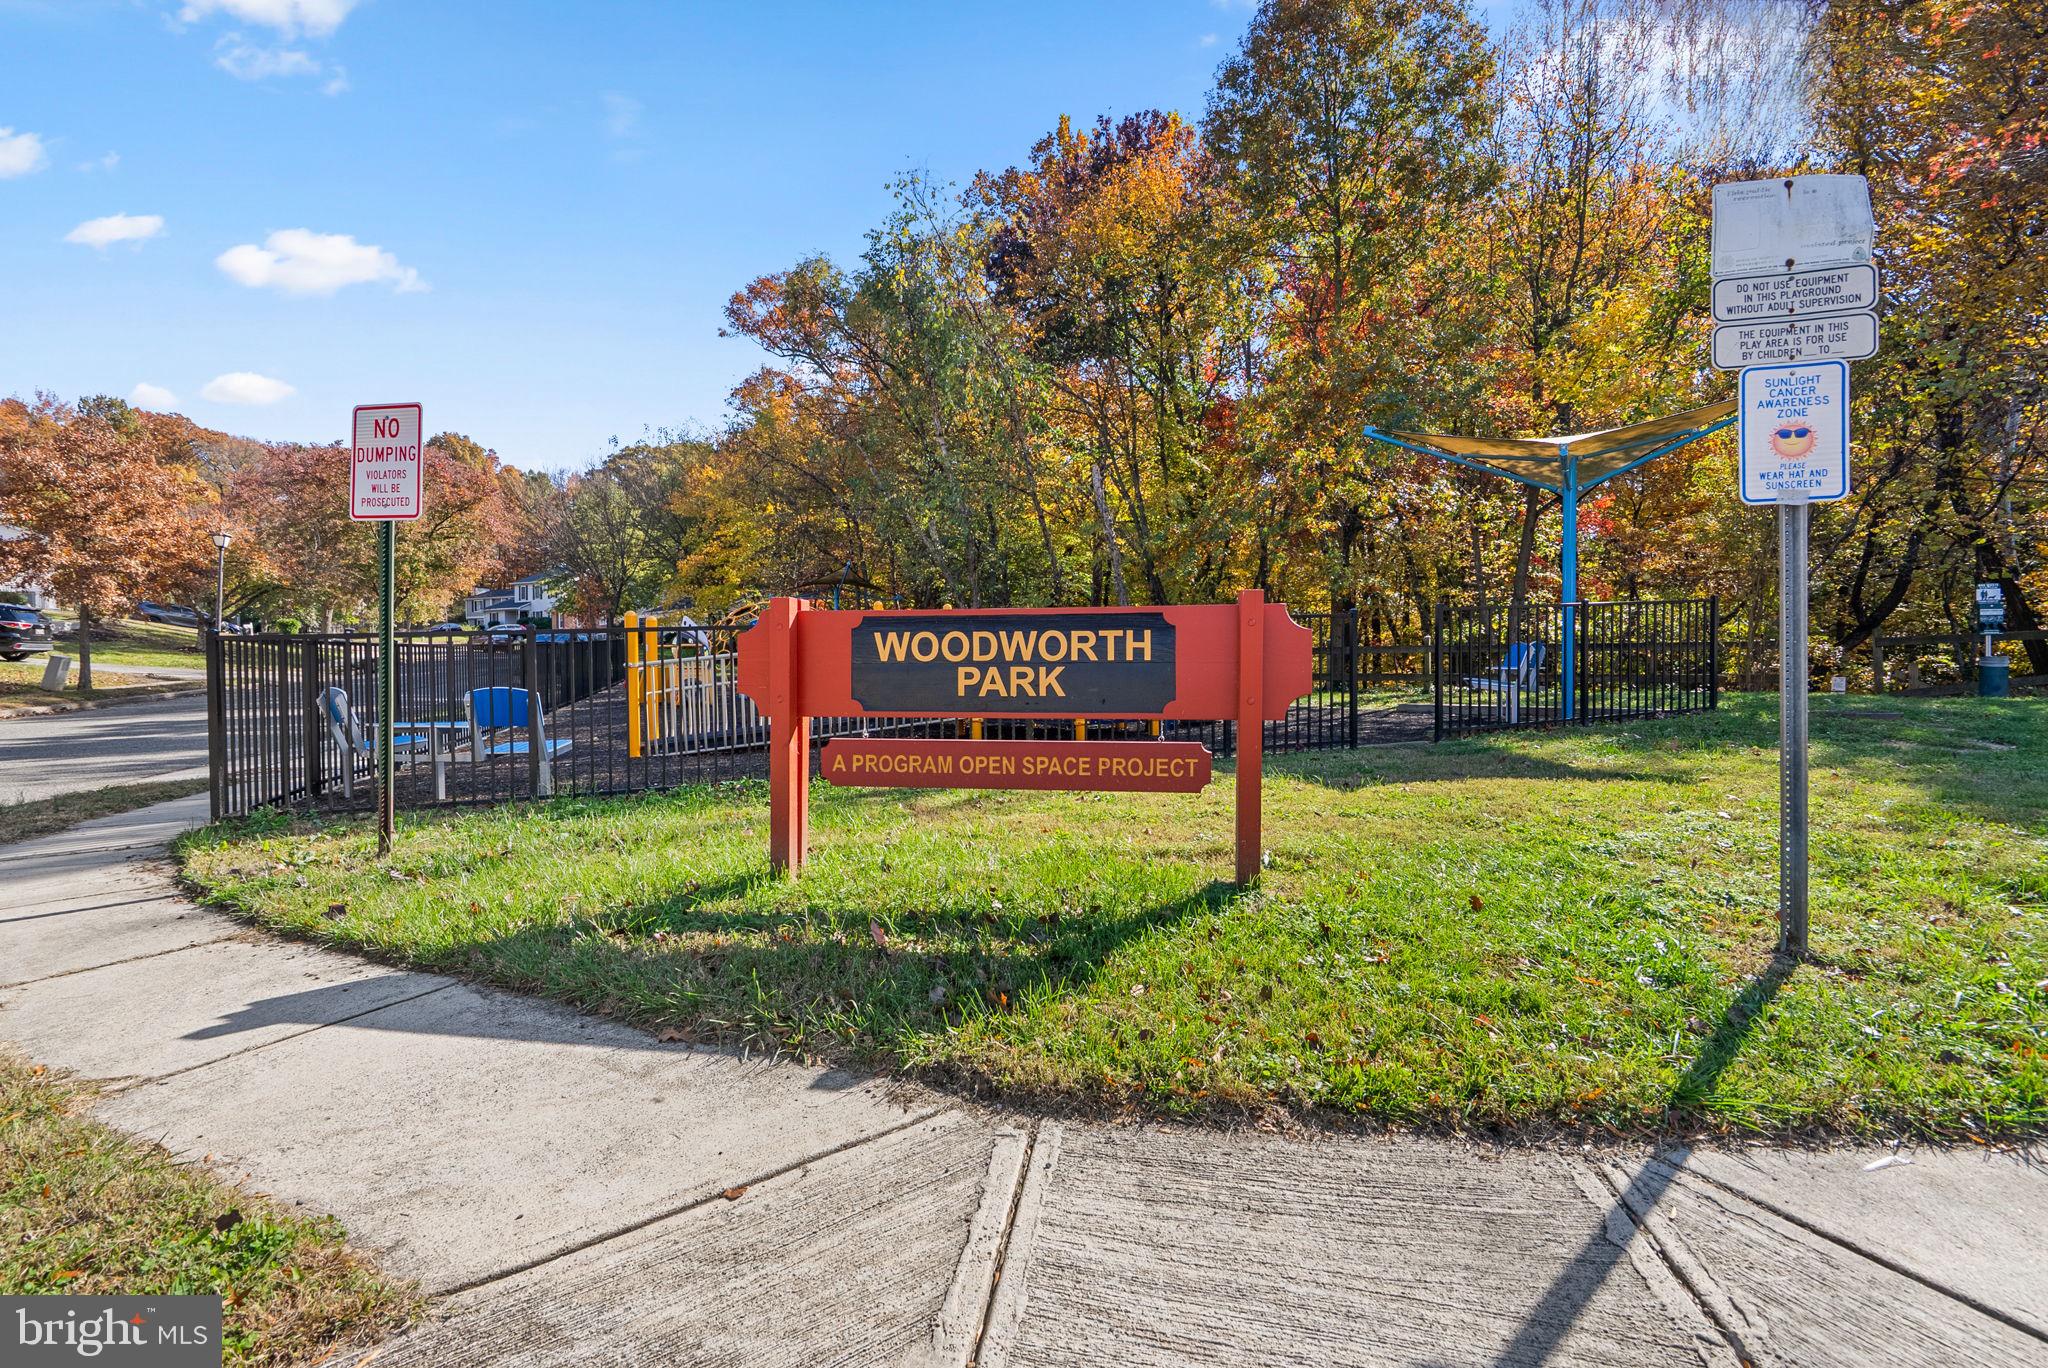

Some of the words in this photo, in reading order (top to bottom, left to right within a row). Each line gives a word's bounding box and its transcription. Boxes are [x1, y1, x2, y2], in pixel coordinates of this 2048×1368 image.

[1736, 284, 1749, 293] DO
[1753, 282, 1770, 292] NOT
[1773, 280, 1791, 290] USE
[1795, 273, 1849, 287] EQUIPMENT
[1744, 294, 1753, 303] IN
[1757, 292, 1776, 302] THIS
[1780, 285, 1841, 300] PLAYGROUND
[1726, 303, 1764, 315] WITHOUT
[1767, 301, 1795, 312] ADULT
[1799, 293, 1862, 309] SUPERVISION
[1739, 330, 1755, 340] THE
[1760, 325, 1811, 338] EQUIPMENT
[1814, 324, 1824, 333] IN
[1828, 322, 1849, 332] THIS
[1740, 341, 1761, 350] PLAY
[1765, 338, 1789, 348] AREA
[1793, 337, 1801, 346] IS
[1806, 335, 1824, 344] FOR
[1828, 333, 1847, 343] USE
[1742, 352, 1753, 361] BY
[1757, 347, 1802, 359] CHILDREN
[1818, 345, 1830, 354] TO
[1764, 374, 1822, 388] SUNLIGHT
[1769, 386, 1816, 398] CANCER
[1757, 395, 1830, 409] AWARENESS
[1777, 408, 1808, 418] ZONE
[374, 418, 400, 438] NO
[357, 445, 416, 463] DUMPING
[1759, 471, 1784, 480] WEAR
[1789, 470, 1805, 479] HAT
[1809, 468, 1828, 477] AND
[1779, 462, 1806, 470] PLEASE
[366, 469, 407, 480] VIOLATORS
[371, 484, 388, 493] WILL
[391, 483, 401, 493] BE
[1765, 479, 1822, 490] SUNSCREEN
[361, 497, 410, 507] PROSECUTED
[874, 629, 1153, 662] WOODWORTH
[957, 666, 1066, 698] PARK
[831, 754, 847, 772] A
[852, 754, 952, 774] PROGRAM
[959, 755, 1015, 775] OPEN
[1022, 756, 1091, 776] SPACE
[1098, 757, 1199, 778] PROJECT
